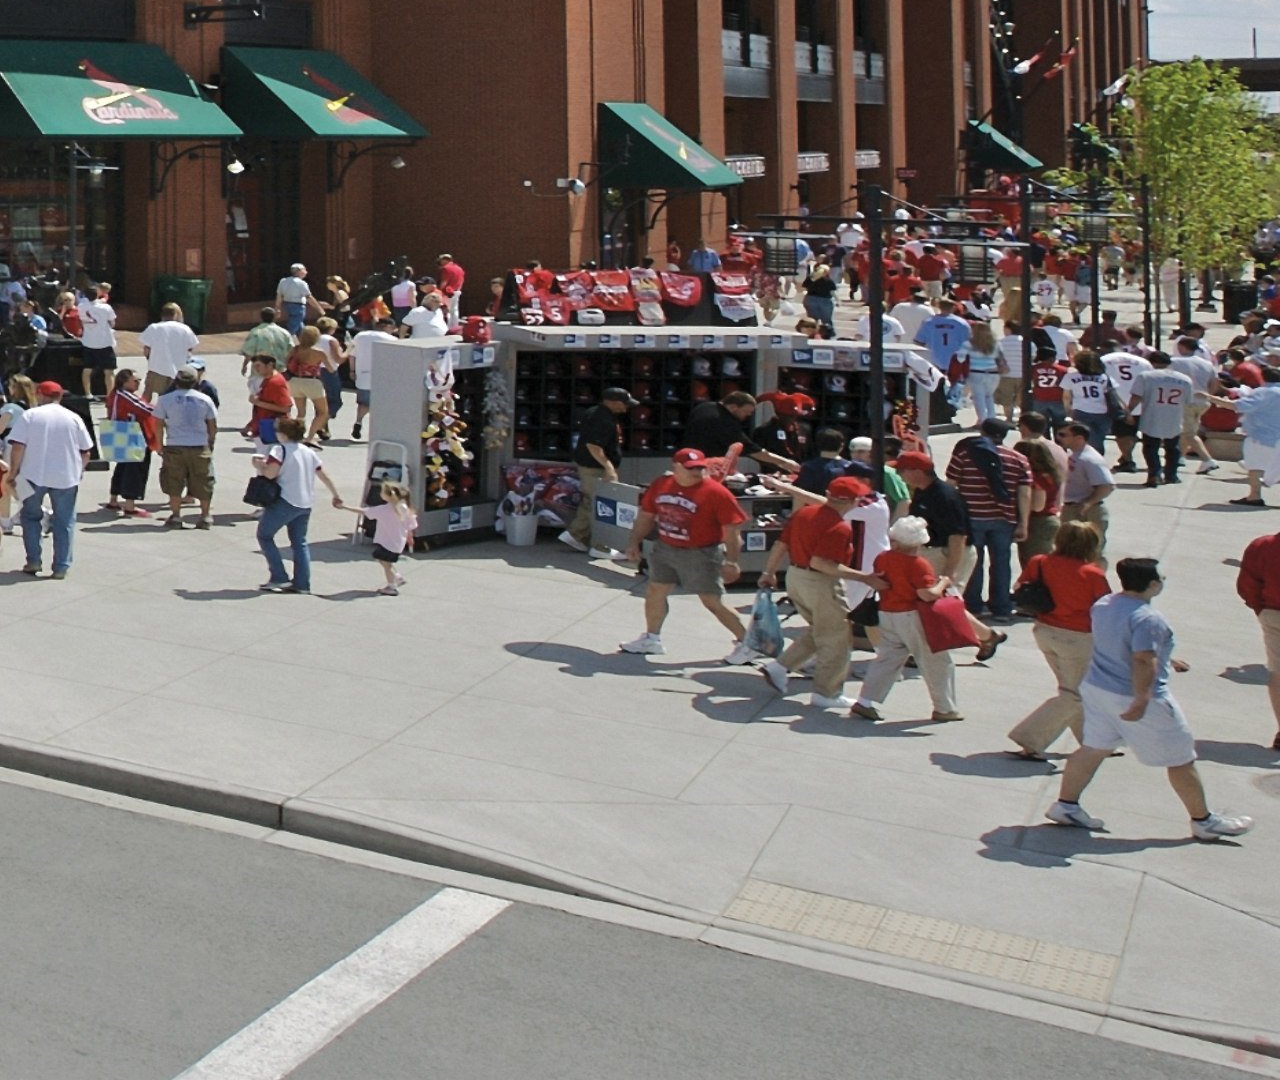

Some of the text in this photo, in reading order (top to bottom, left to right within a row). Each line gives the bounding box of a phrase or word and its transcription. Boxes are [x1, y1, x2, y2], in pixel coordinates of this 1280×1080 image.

[82, 97, 179, 124] Cardinals
[942, 332, 948, 346] 1
[1118, 365, 1133, 381] 5
[1037, 375, 1058, 388] 27
[1081, 385, 1100, 399] 16
[1155, 386, 1183, 405] 12
